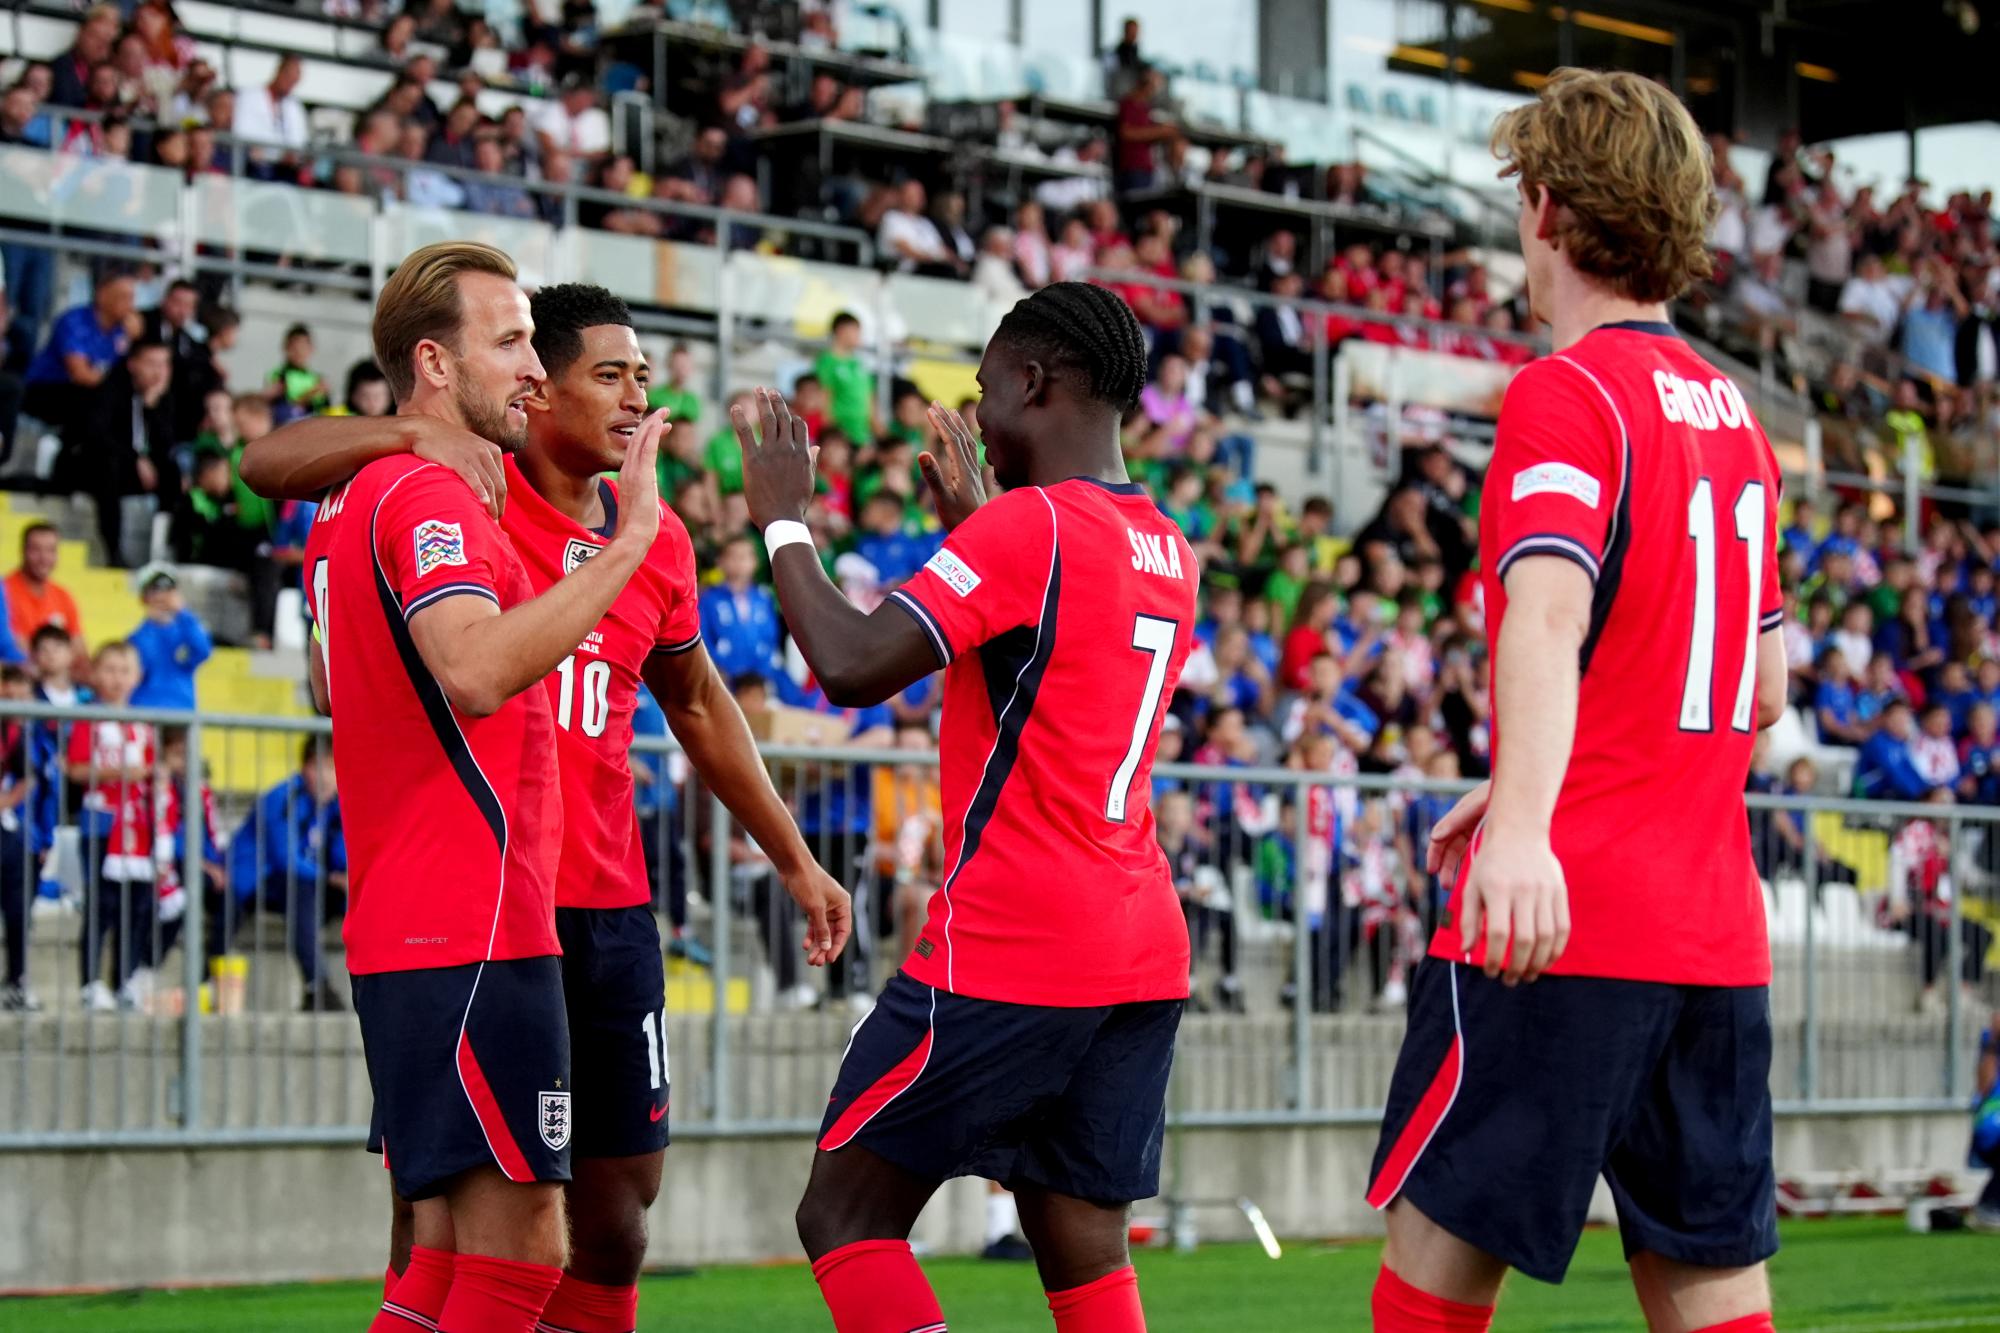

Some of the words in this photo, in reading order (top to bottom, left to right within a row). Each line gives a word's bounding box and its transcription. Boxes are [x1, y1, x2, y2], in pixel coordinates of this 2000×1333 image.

[1127, 527, 1184, 580] SAKA
[585, 631, 604, 644] ATIA
[1678, 477, 1765, 733] 11
[556, 654, 612, 739] 10
[1106, 612, 1179, 824] 7
[404, 936, 449, 944] AERO-FIT
